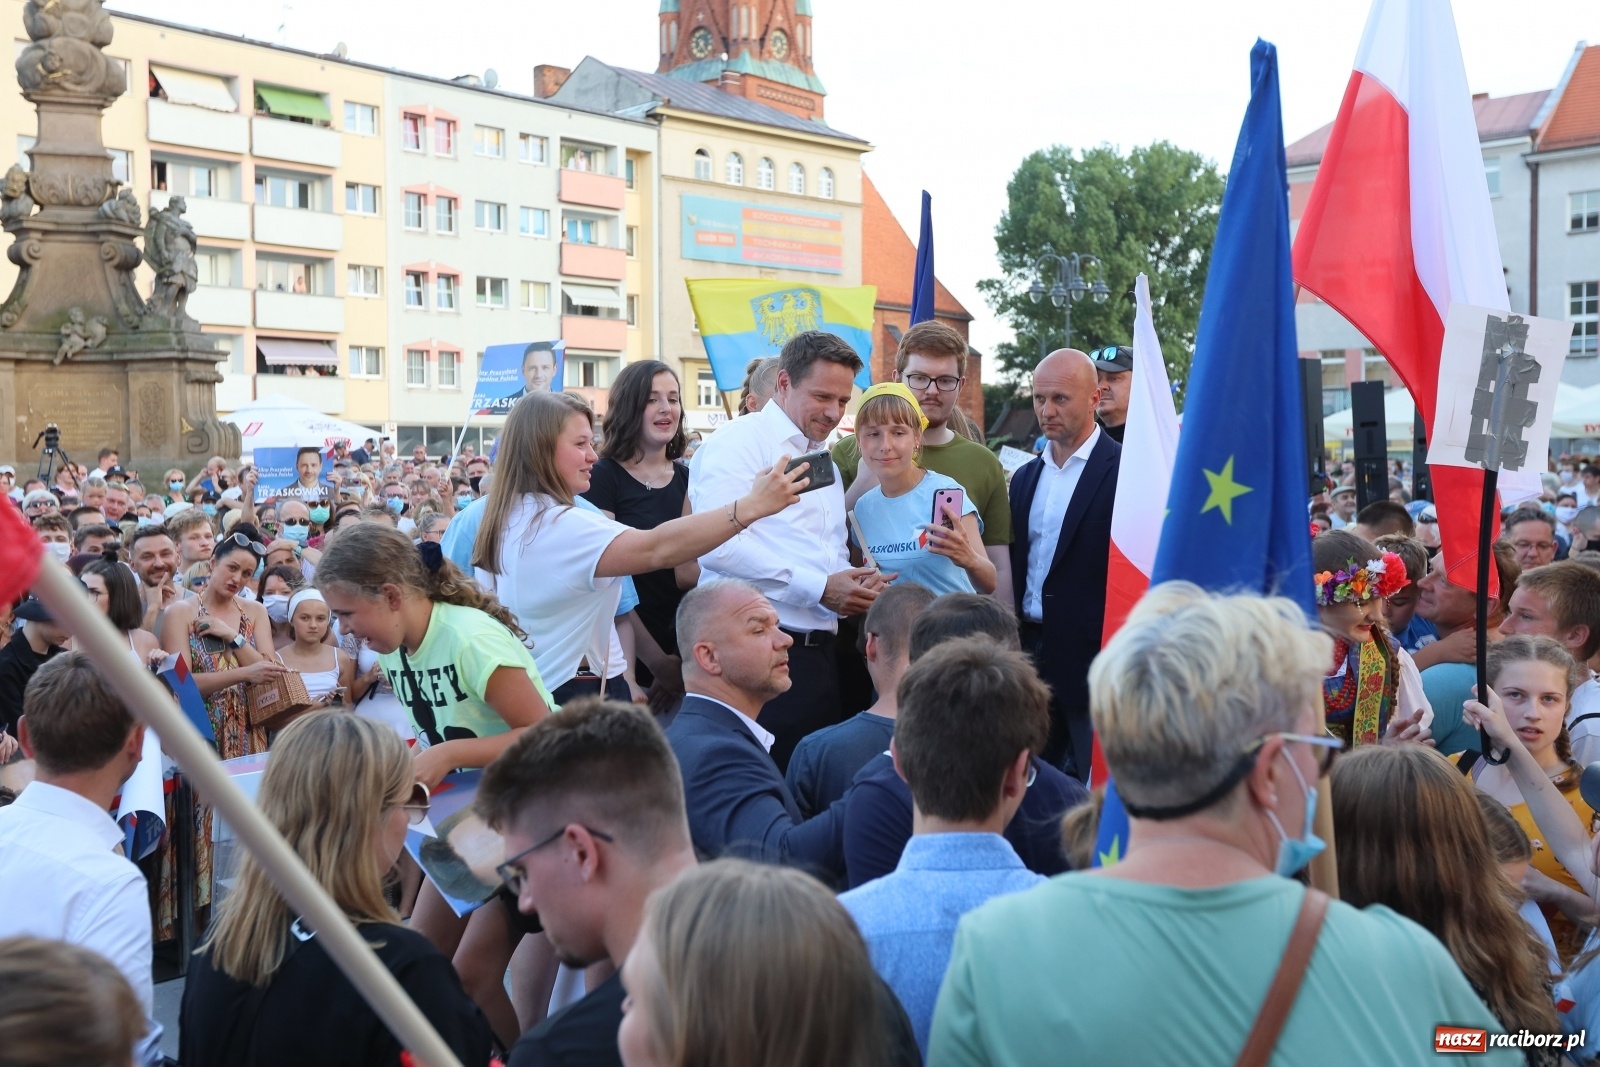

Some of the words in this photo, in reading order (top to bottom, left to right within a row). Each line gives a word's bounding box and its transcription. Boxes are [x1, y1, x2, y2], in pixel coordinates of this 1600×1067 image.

[489, 367, 518, 376] Prezydent
[499, 374, 519, 382] Polska
[257, 486, 329, 497] TRZASKOWSKI
[868, 541, 917, 554] ASKOWSKI
